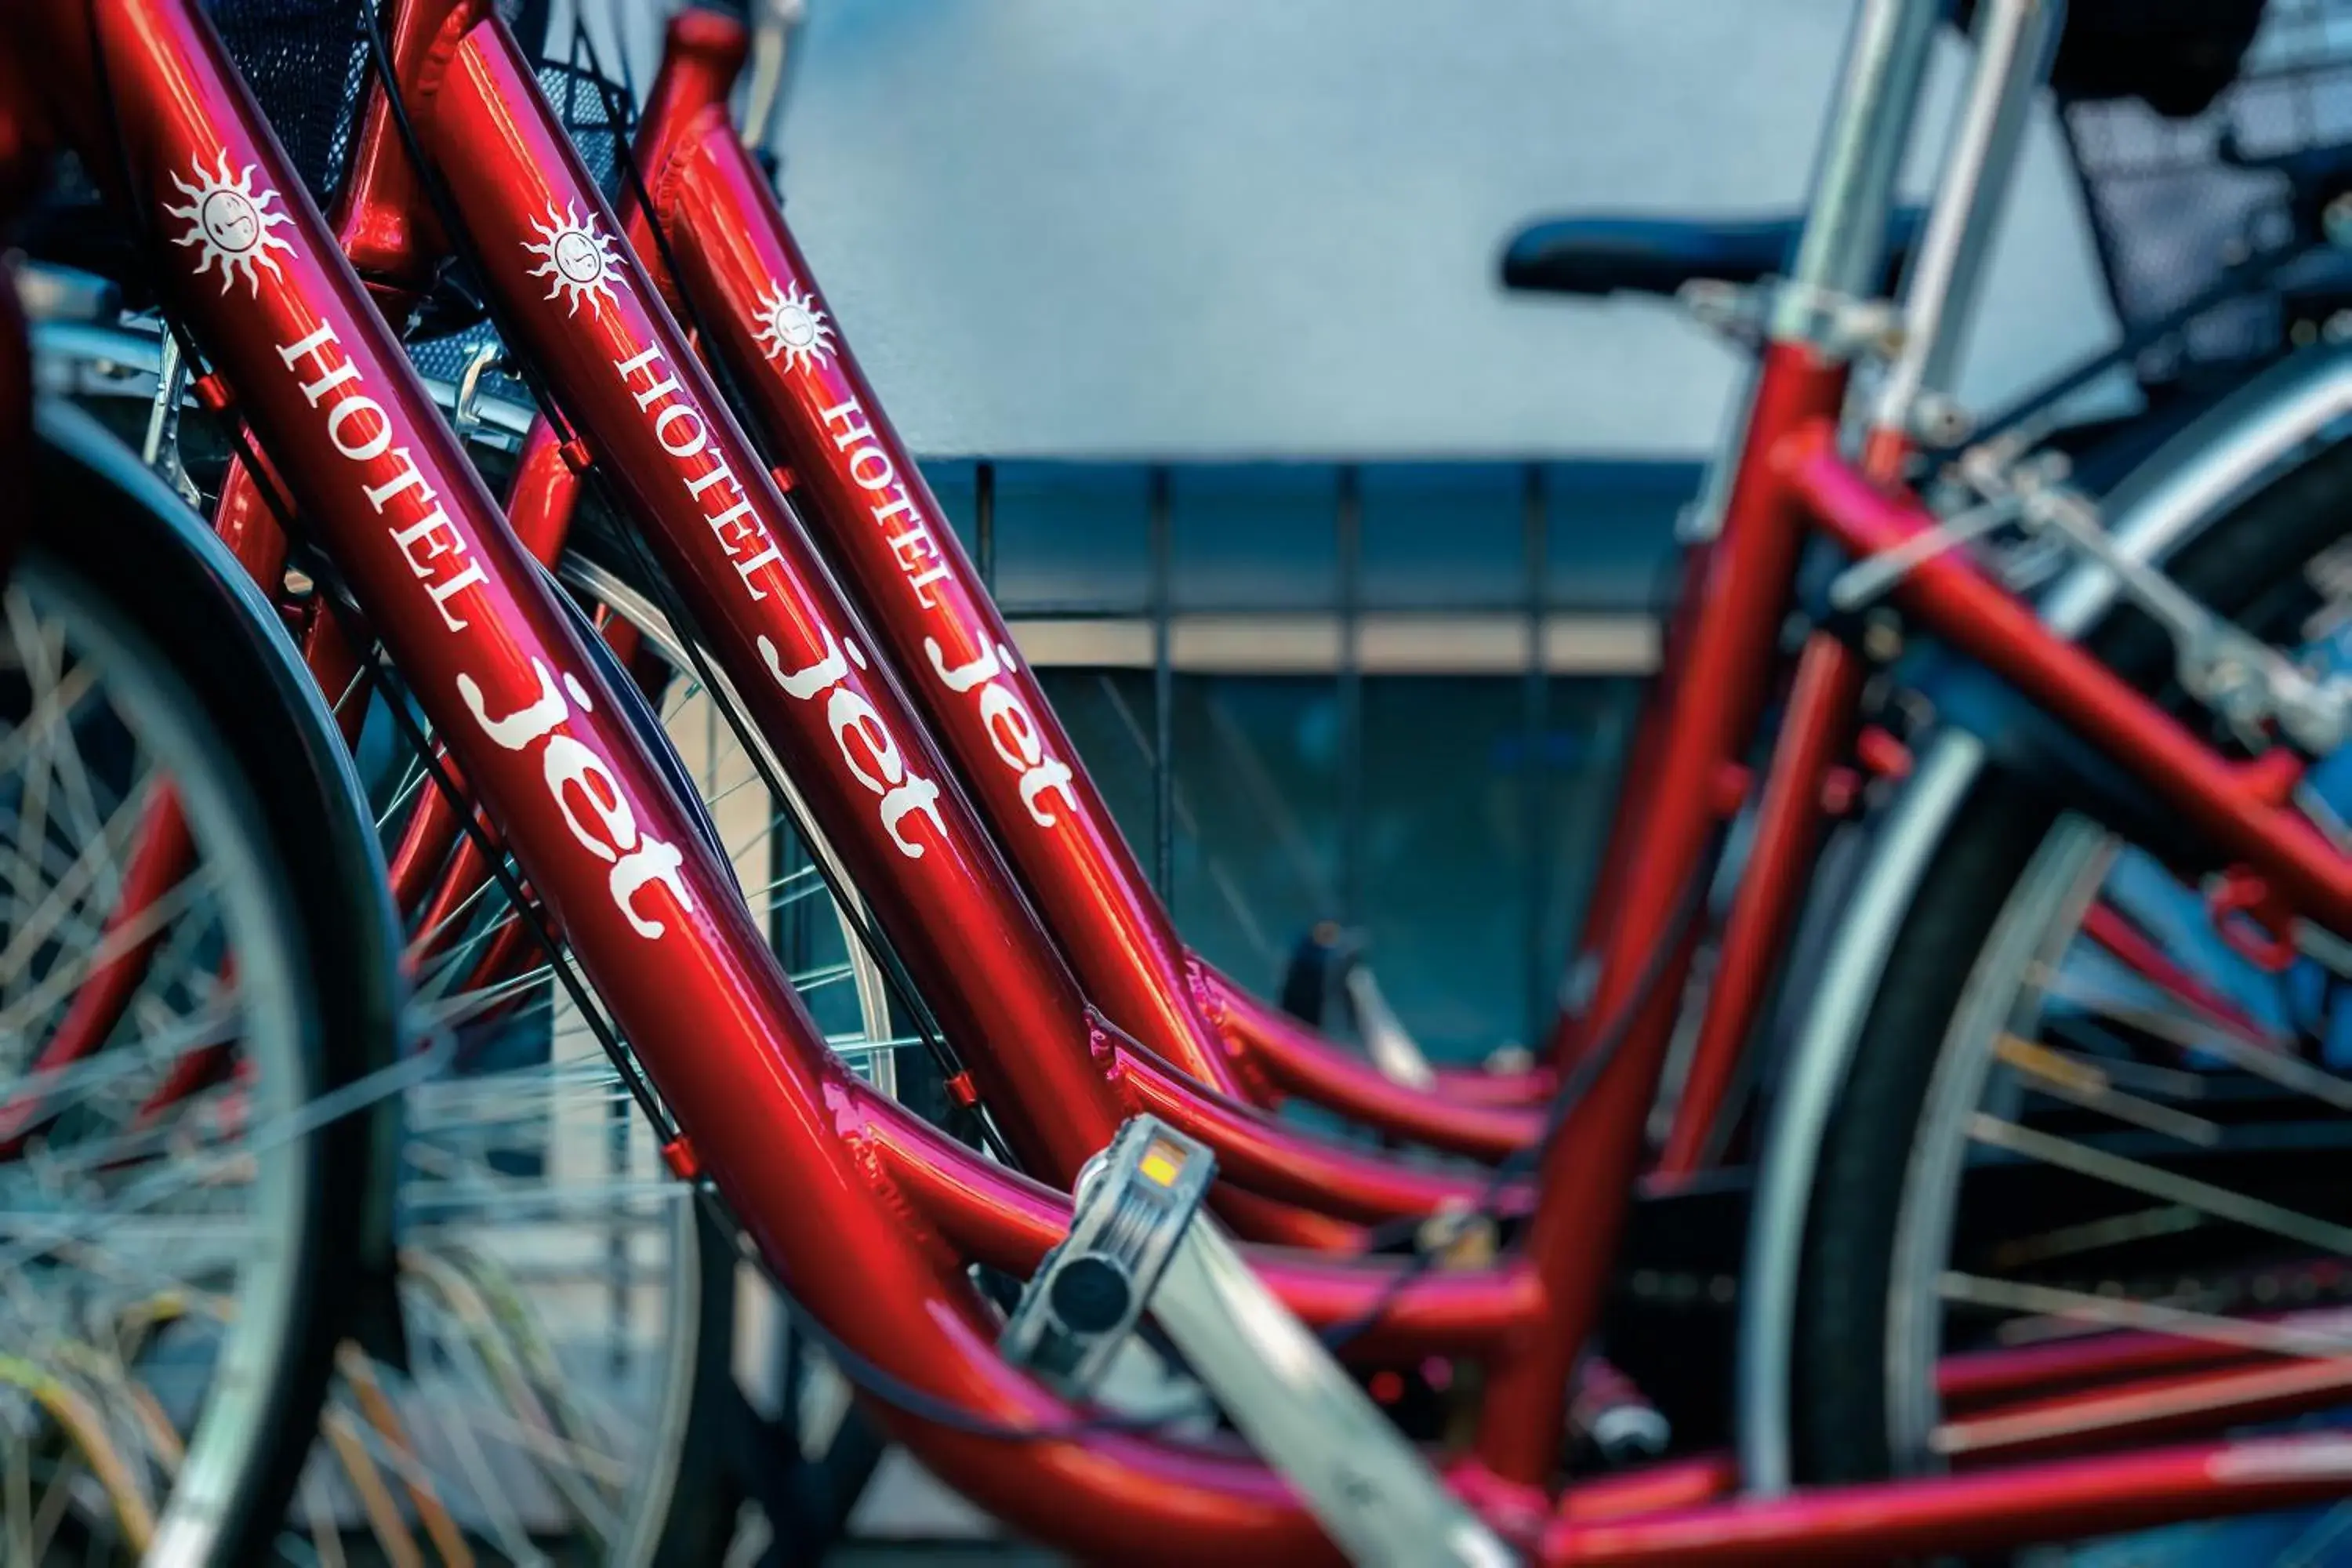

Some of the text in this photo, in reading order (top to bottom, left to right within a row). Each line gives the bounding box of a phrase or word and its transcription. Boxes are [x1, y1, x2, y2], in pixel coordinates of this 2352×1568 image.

[275, 318, 693, 939] HOTEL jet
[614, 339, 947, 858] HOTEL jet
[820, 395, 1076, 828] HOTEL jet
